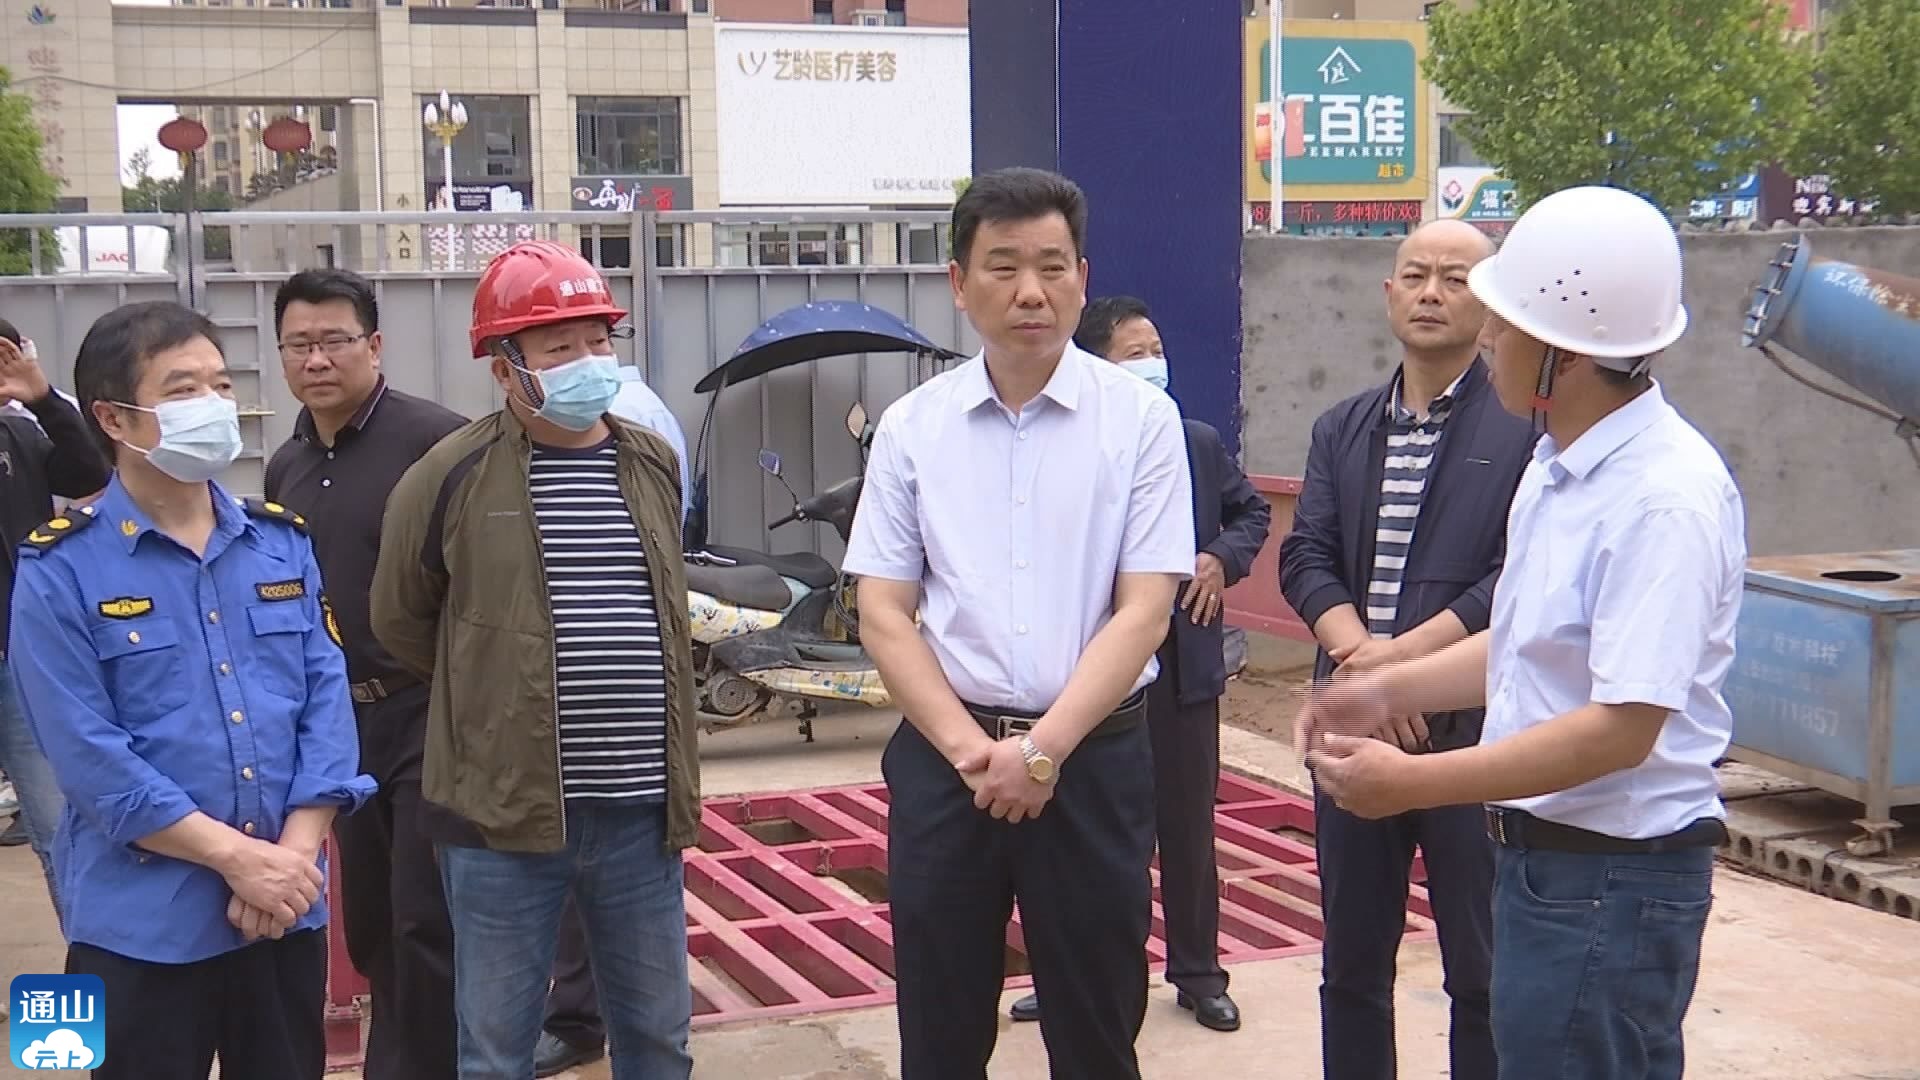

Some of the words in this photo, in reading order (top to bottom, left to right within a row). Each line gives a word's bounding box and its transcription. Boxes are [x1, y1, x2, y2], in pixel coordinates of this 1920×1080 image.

[774, 49, 897, 82] 艺龄医疗美容
[1285, 93, 1405, 143] 百佳
[1303, 146, 1404, 157] ERMARKET
[1377, 163, 1405, 177] 超市
[96, 252, 129, 263] JAC
